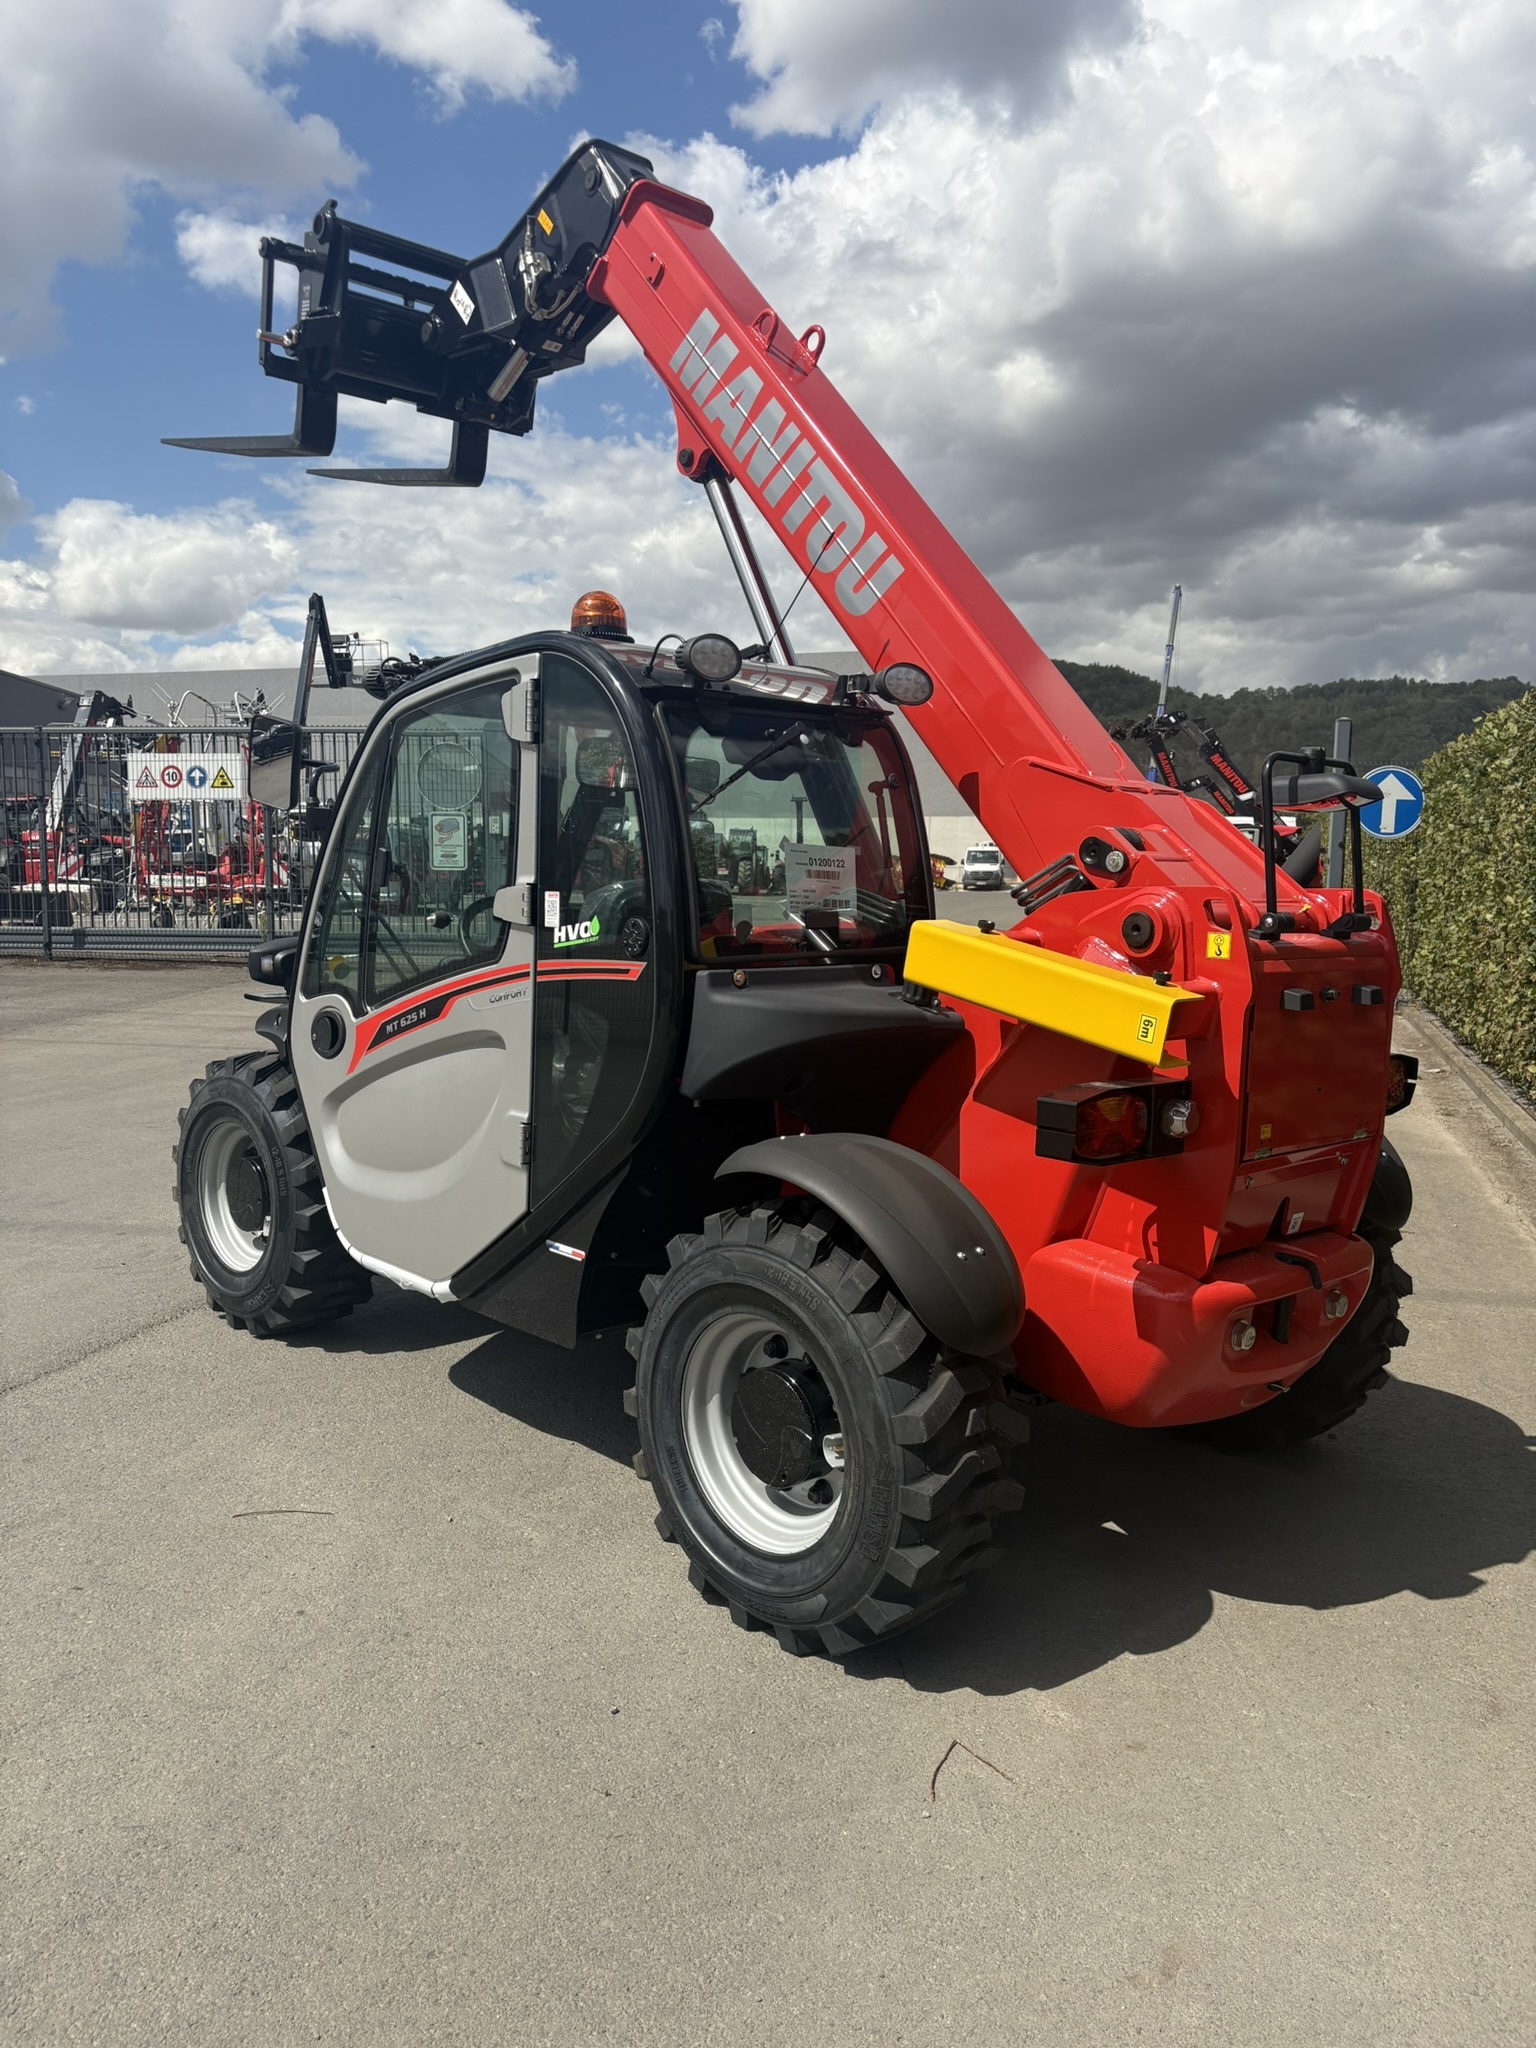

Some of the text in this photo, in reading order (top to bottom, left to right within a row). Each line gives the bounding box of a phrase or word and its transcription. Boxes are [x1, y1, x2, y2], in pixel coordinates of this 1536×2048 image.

[668, 306, 905, 617] MANITOU
[165, 770, 178, 783] 10
[1157, 751, 1178, 788] MANITOU
[1209, 752, 1249, 794] MANITOU
[1213, 790, 1235, 815] MANITOU
[808, 857, 846, 868] 01200122
[553, 921, 592, 944] HVO
[386, 1008, 427, 1034] MT 625 H
[1140, 1019, 1153, 1039] 6m
